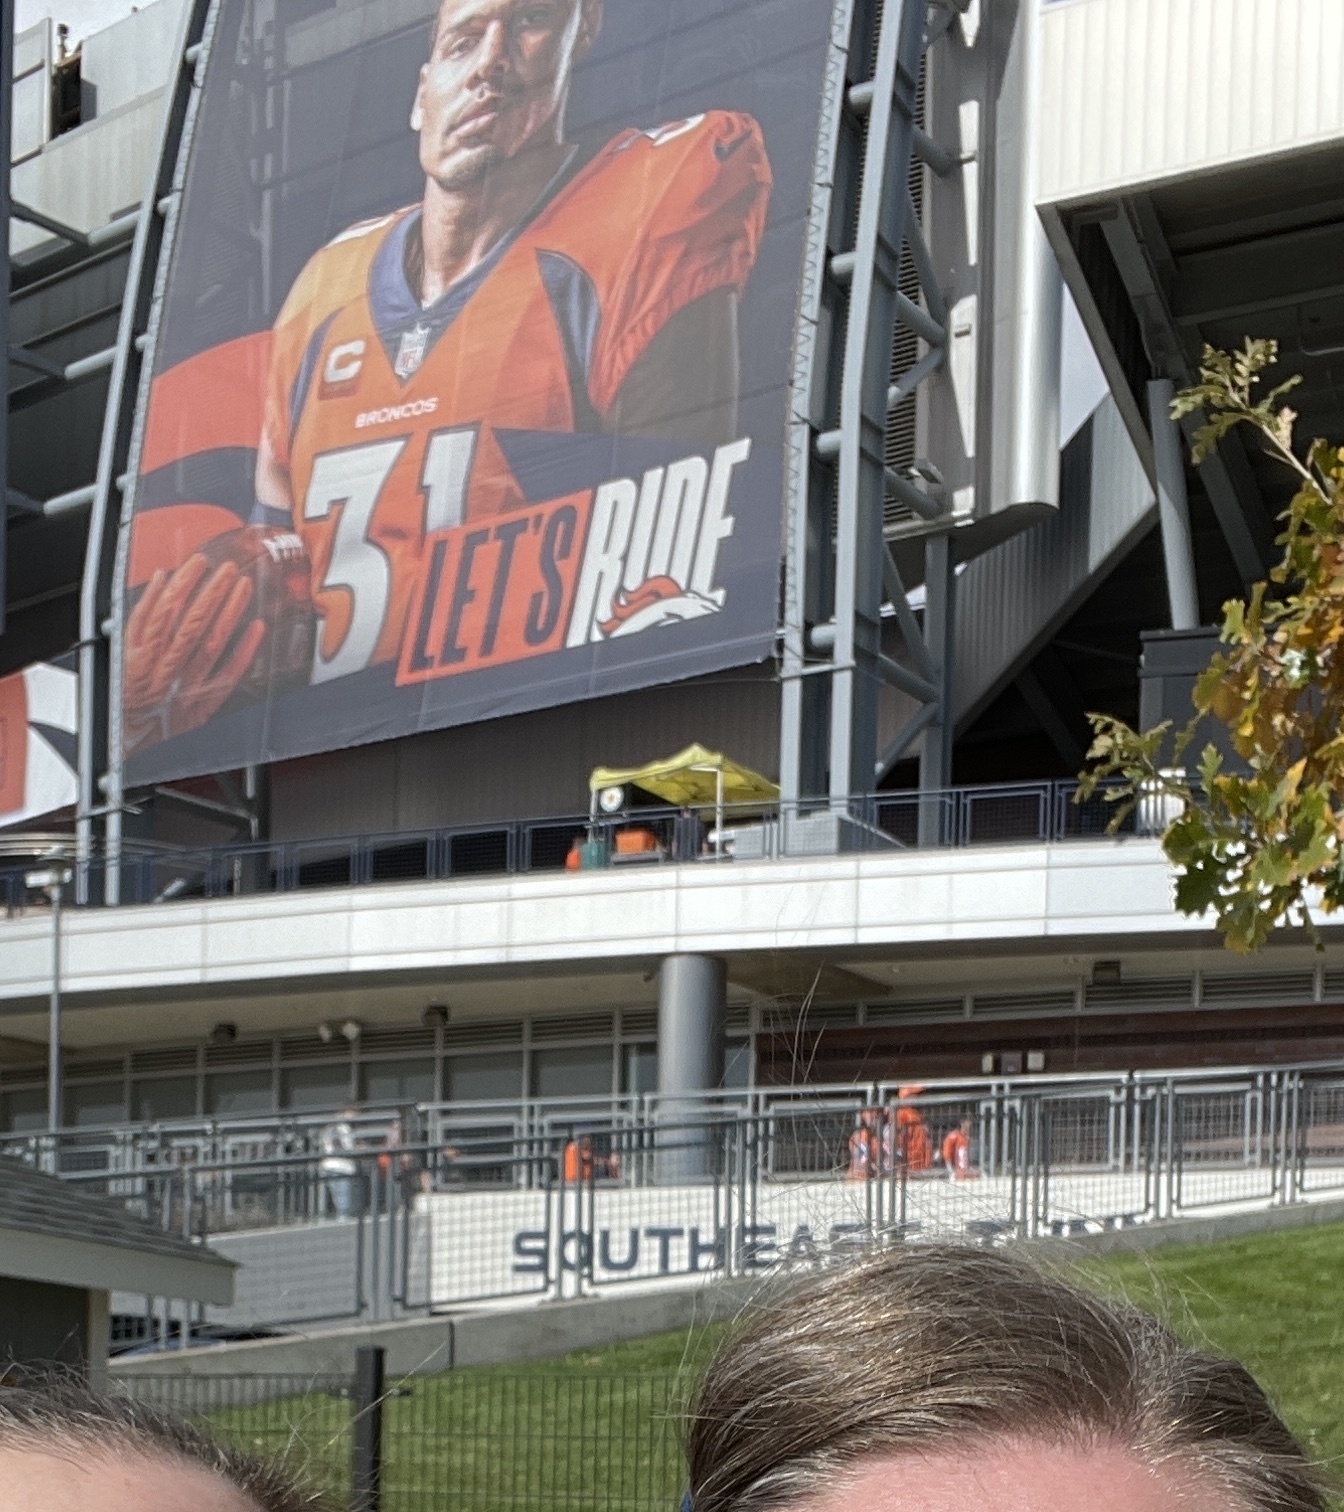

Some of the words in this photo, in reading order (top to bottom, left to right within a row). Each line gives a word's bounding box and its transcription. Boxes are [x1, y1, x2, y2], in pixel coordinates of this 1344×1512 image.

[324, 340, 366, 383] C
[355, 397, 439, 428] BRONCOS
[408, 504, 579, 673] LET'S
[566, 437, 752, 649] RIDE
